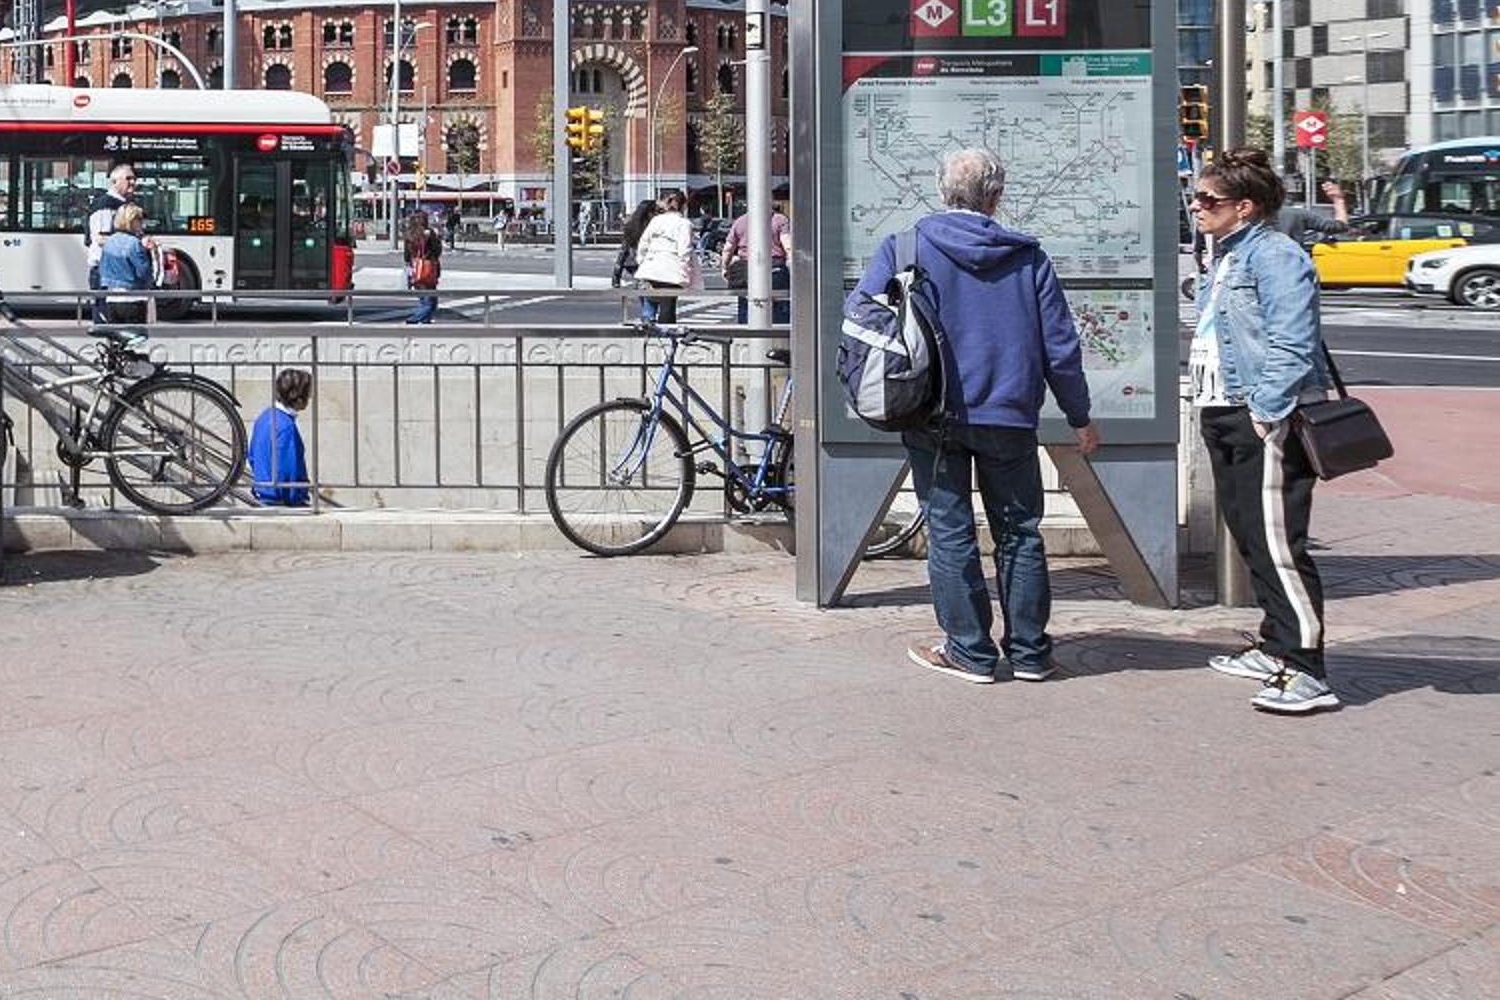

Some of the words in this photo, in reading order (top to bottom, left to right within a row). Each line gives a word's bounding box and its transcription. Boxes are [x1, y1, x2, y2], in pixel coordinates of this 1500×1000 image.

[926, 5, 943, 19] M
[190, 218, 215, 232] 165
[338, 338, 471, 364] metro
